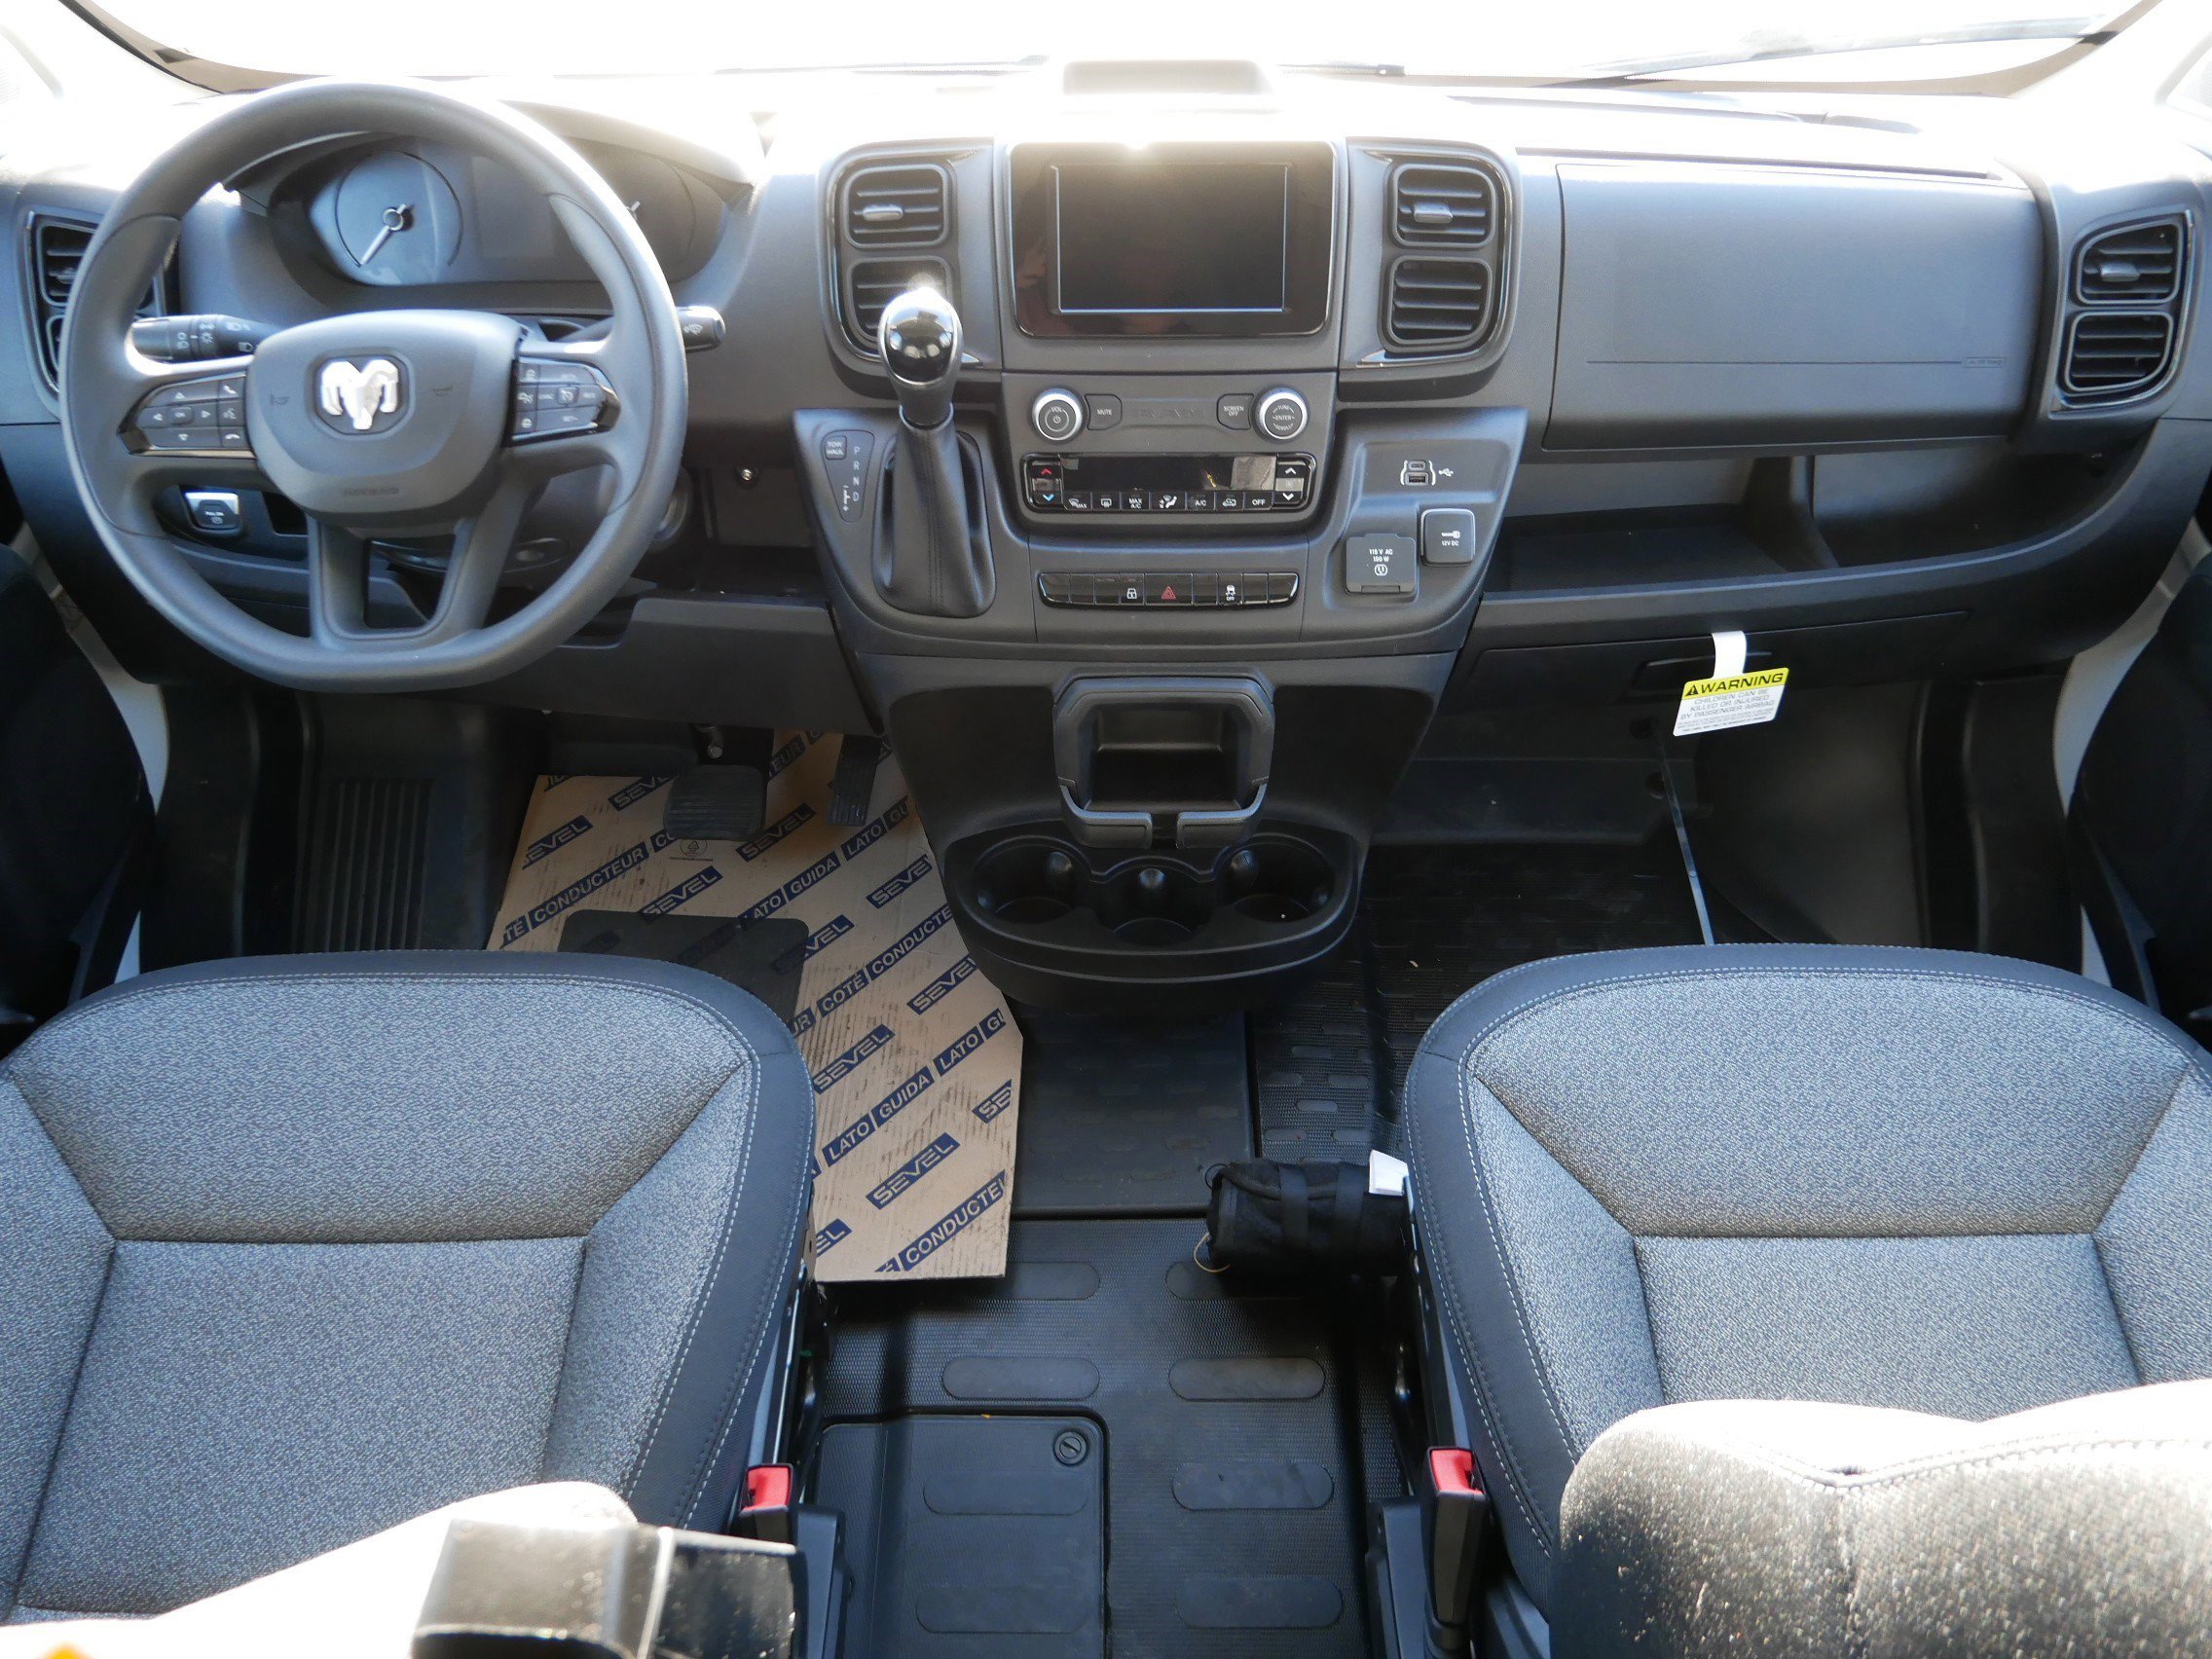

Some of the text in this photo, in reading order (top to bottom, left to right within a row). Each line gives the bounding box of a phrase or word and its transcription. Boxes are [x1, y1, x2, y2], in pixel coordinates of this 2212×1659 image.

[853, 461, 861, 470] R
[854, 446, 861, 455] P
[853, 476, 860, 486] N
[853, 491, 860, 502] D
[1701, 673, 1784, 693] WARNING
[1690, 702, 1718, 712] KILLED
[1733, 695, 1770, 706] INJURED
[1693, 706, 1743, 718] PASSENGER
[1694, 693, 1736, 705] CHILDREN
[741, 812, 812, 859] SEVEL
[847, 824, 882, 855] LATO
[534, 847, 645, 923] CONDUCTEUR
[791, 857, 837, 894] GUIDA
[644, 874, 719, 914] SEVEL
[813, 1034, 890, 1090] SEVEL
[940, 1033, 978, 1071] LATO
[828, 1074, 930, 1161] LATO GUIDA
[872, 1142, 955, 1207] SEVEL
